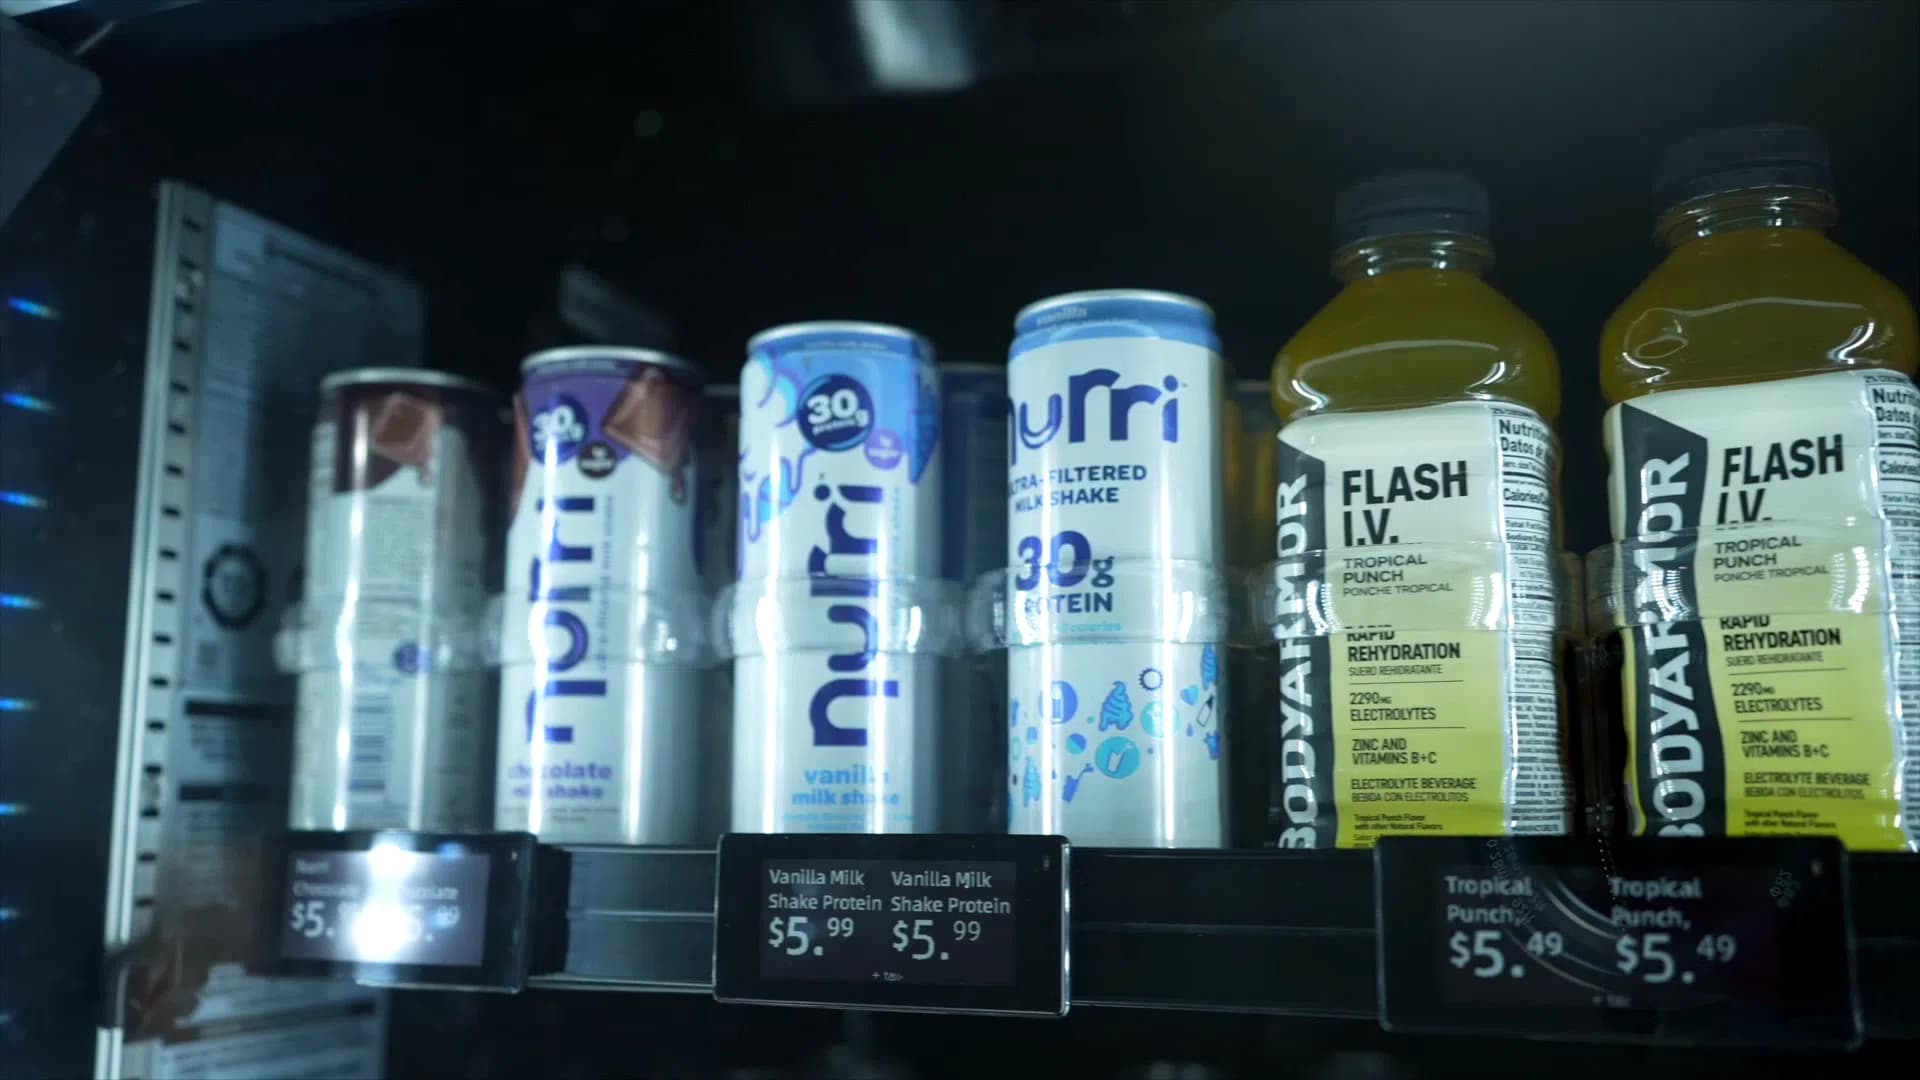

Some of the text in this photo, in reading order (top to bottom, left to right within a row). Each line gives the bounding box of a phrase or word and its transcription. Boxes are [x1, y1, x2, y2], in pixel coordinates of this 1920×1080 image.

[1721, 434, 1844, 487] FLASH
[1008, 463, 1148, 497] LTRA-FILTERED
[1342, 459, 1468, 506] FLASH
[1050, 487, 1119, 506] SHAKE
[1716, 488, 1773, 529] I.V.
[1344, 508, 1399, 547] I.V.
[1714, 536, 1802, 554] TROPICAL
[1014, 530, 1115, 591] 30g
[1343, 553, 1427, 570] TROPICAL
[1714, 553, 1777, 569] PUNCH
[1343, 569, 1404, 584] PUNCH
[1714, 564, 1830, 583] PONCHE TROPICAL
[1343, 582, 1453, 597] PONCHE TROPICAL
[1024, 592, 1113, 614] RTEIN
[808, 484, 899, 747] nurri
[1634, 451, 1706, 837] ODYARMOR
[1723, 628, 1842, 652] REHYDRATION
[1347, 642, 1461, 663] REHYDRATION
[1350, 707, 1437, 722] ELECTROLYTES
[1735, 697, 1823, 714] ELECTROLYTES
[1352, 737, 1407, 751] ZINC AND
[1740, 730, 1798, 745] ZINC AND
[1352, 751, 1438, 765] VITAMINS B+C
[1742, 744, 1830, 759] VITAMINS B+C
[1351, 777, 1477, 790] ELECTROLYTE BEVERAGE
[1743, 772, 1870, 786] ELECTROLYTE BEVERAGE
[791, 787, 836, 806] milk
[768, 869, 865, 886] Vanilla Milk
[891, 870, 992, 889] Vanilla Milk
[1445, 876, 1533, 897] Tropical
[1609, 877, 1702, 901] Tropical
[768, 893, 882, 911] Shake Protein
[890, 896, 1011, 914] Shake Protein
[1447, 905, 1521, 926] Punch,
[1611, 905, 1691, 929] Punch,
